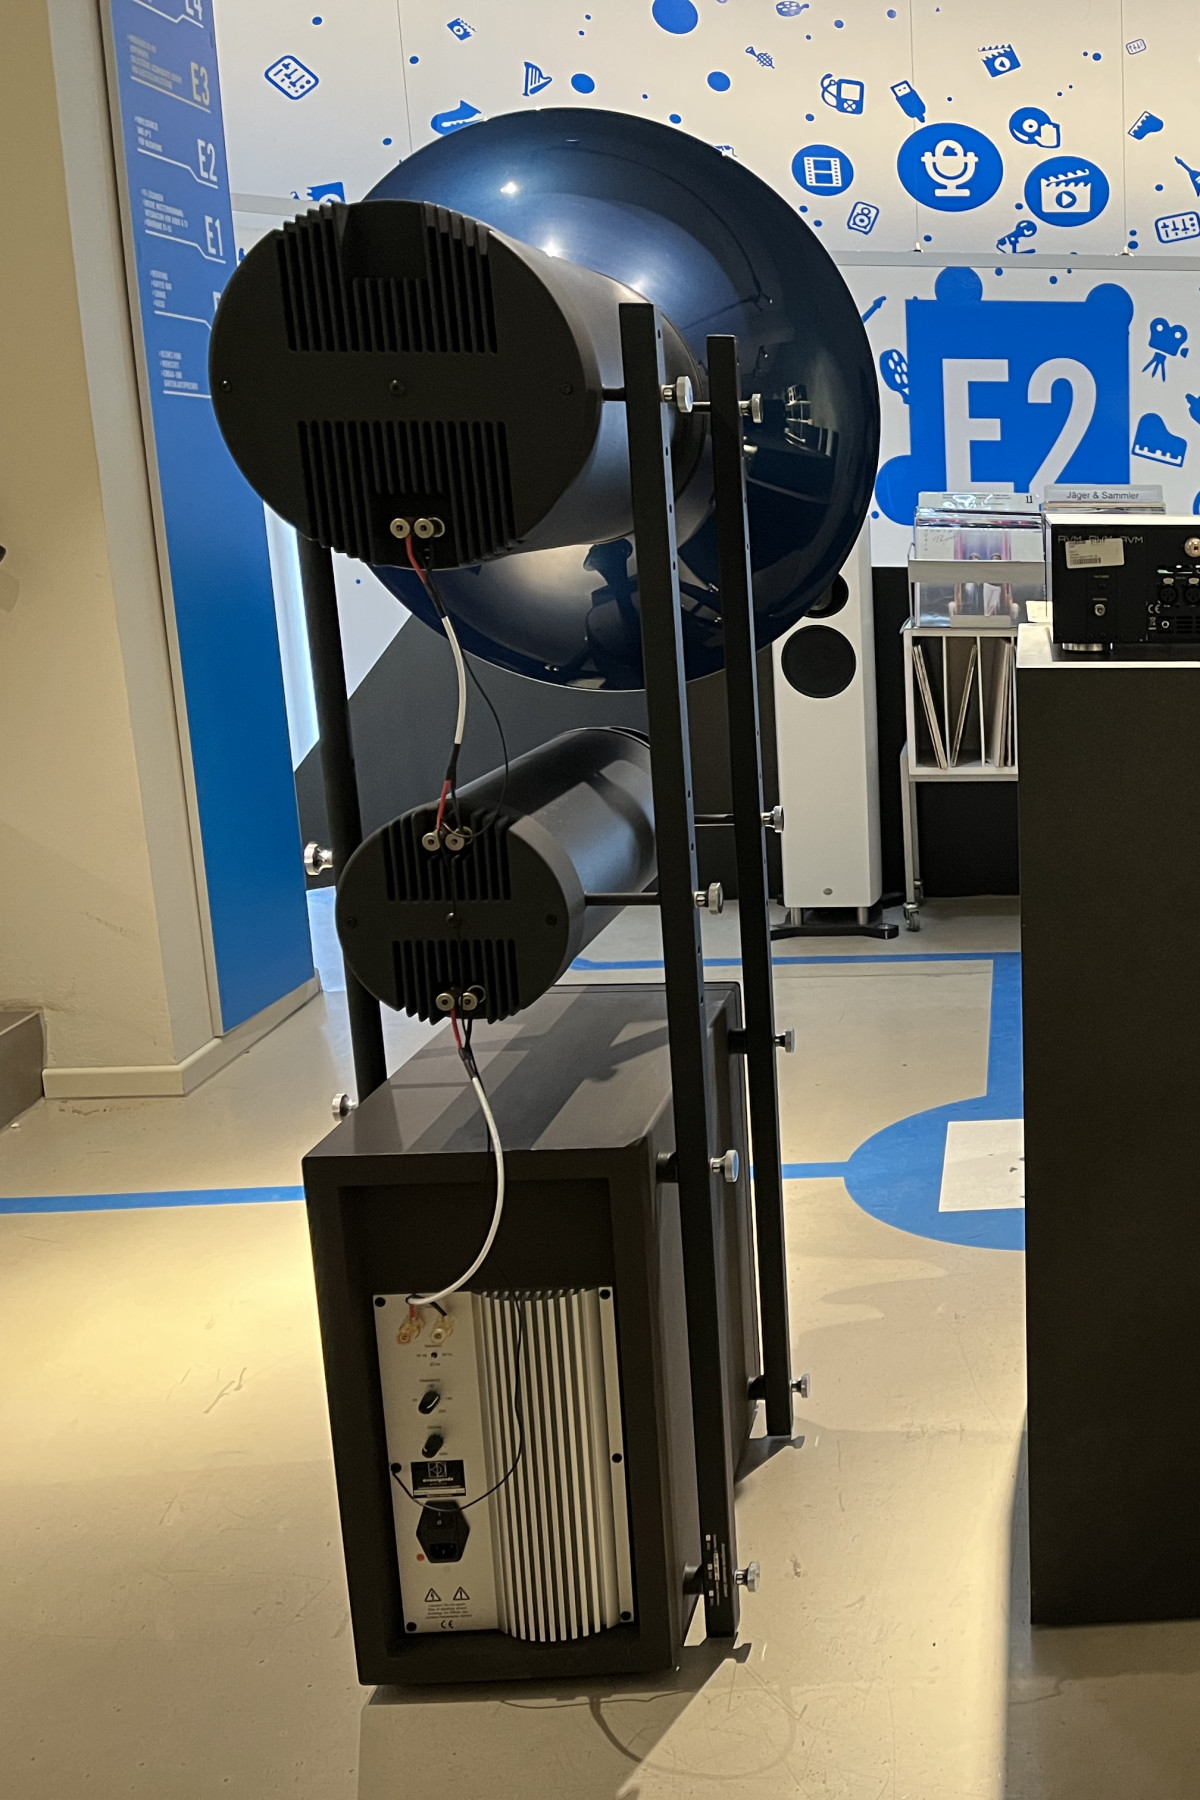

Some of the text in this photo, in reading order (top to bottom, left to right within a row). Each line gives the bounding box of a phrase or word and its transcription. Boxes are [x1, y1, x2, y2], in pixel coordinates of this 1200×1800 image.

[190, 61, 210, 106] E3
[197, 138, 218, 182] E2
[204, 215, 224, 257] E1
[942, 357, 1097, 493] E2
[1067, 491, 1139, 501] Jäger & Sammler
